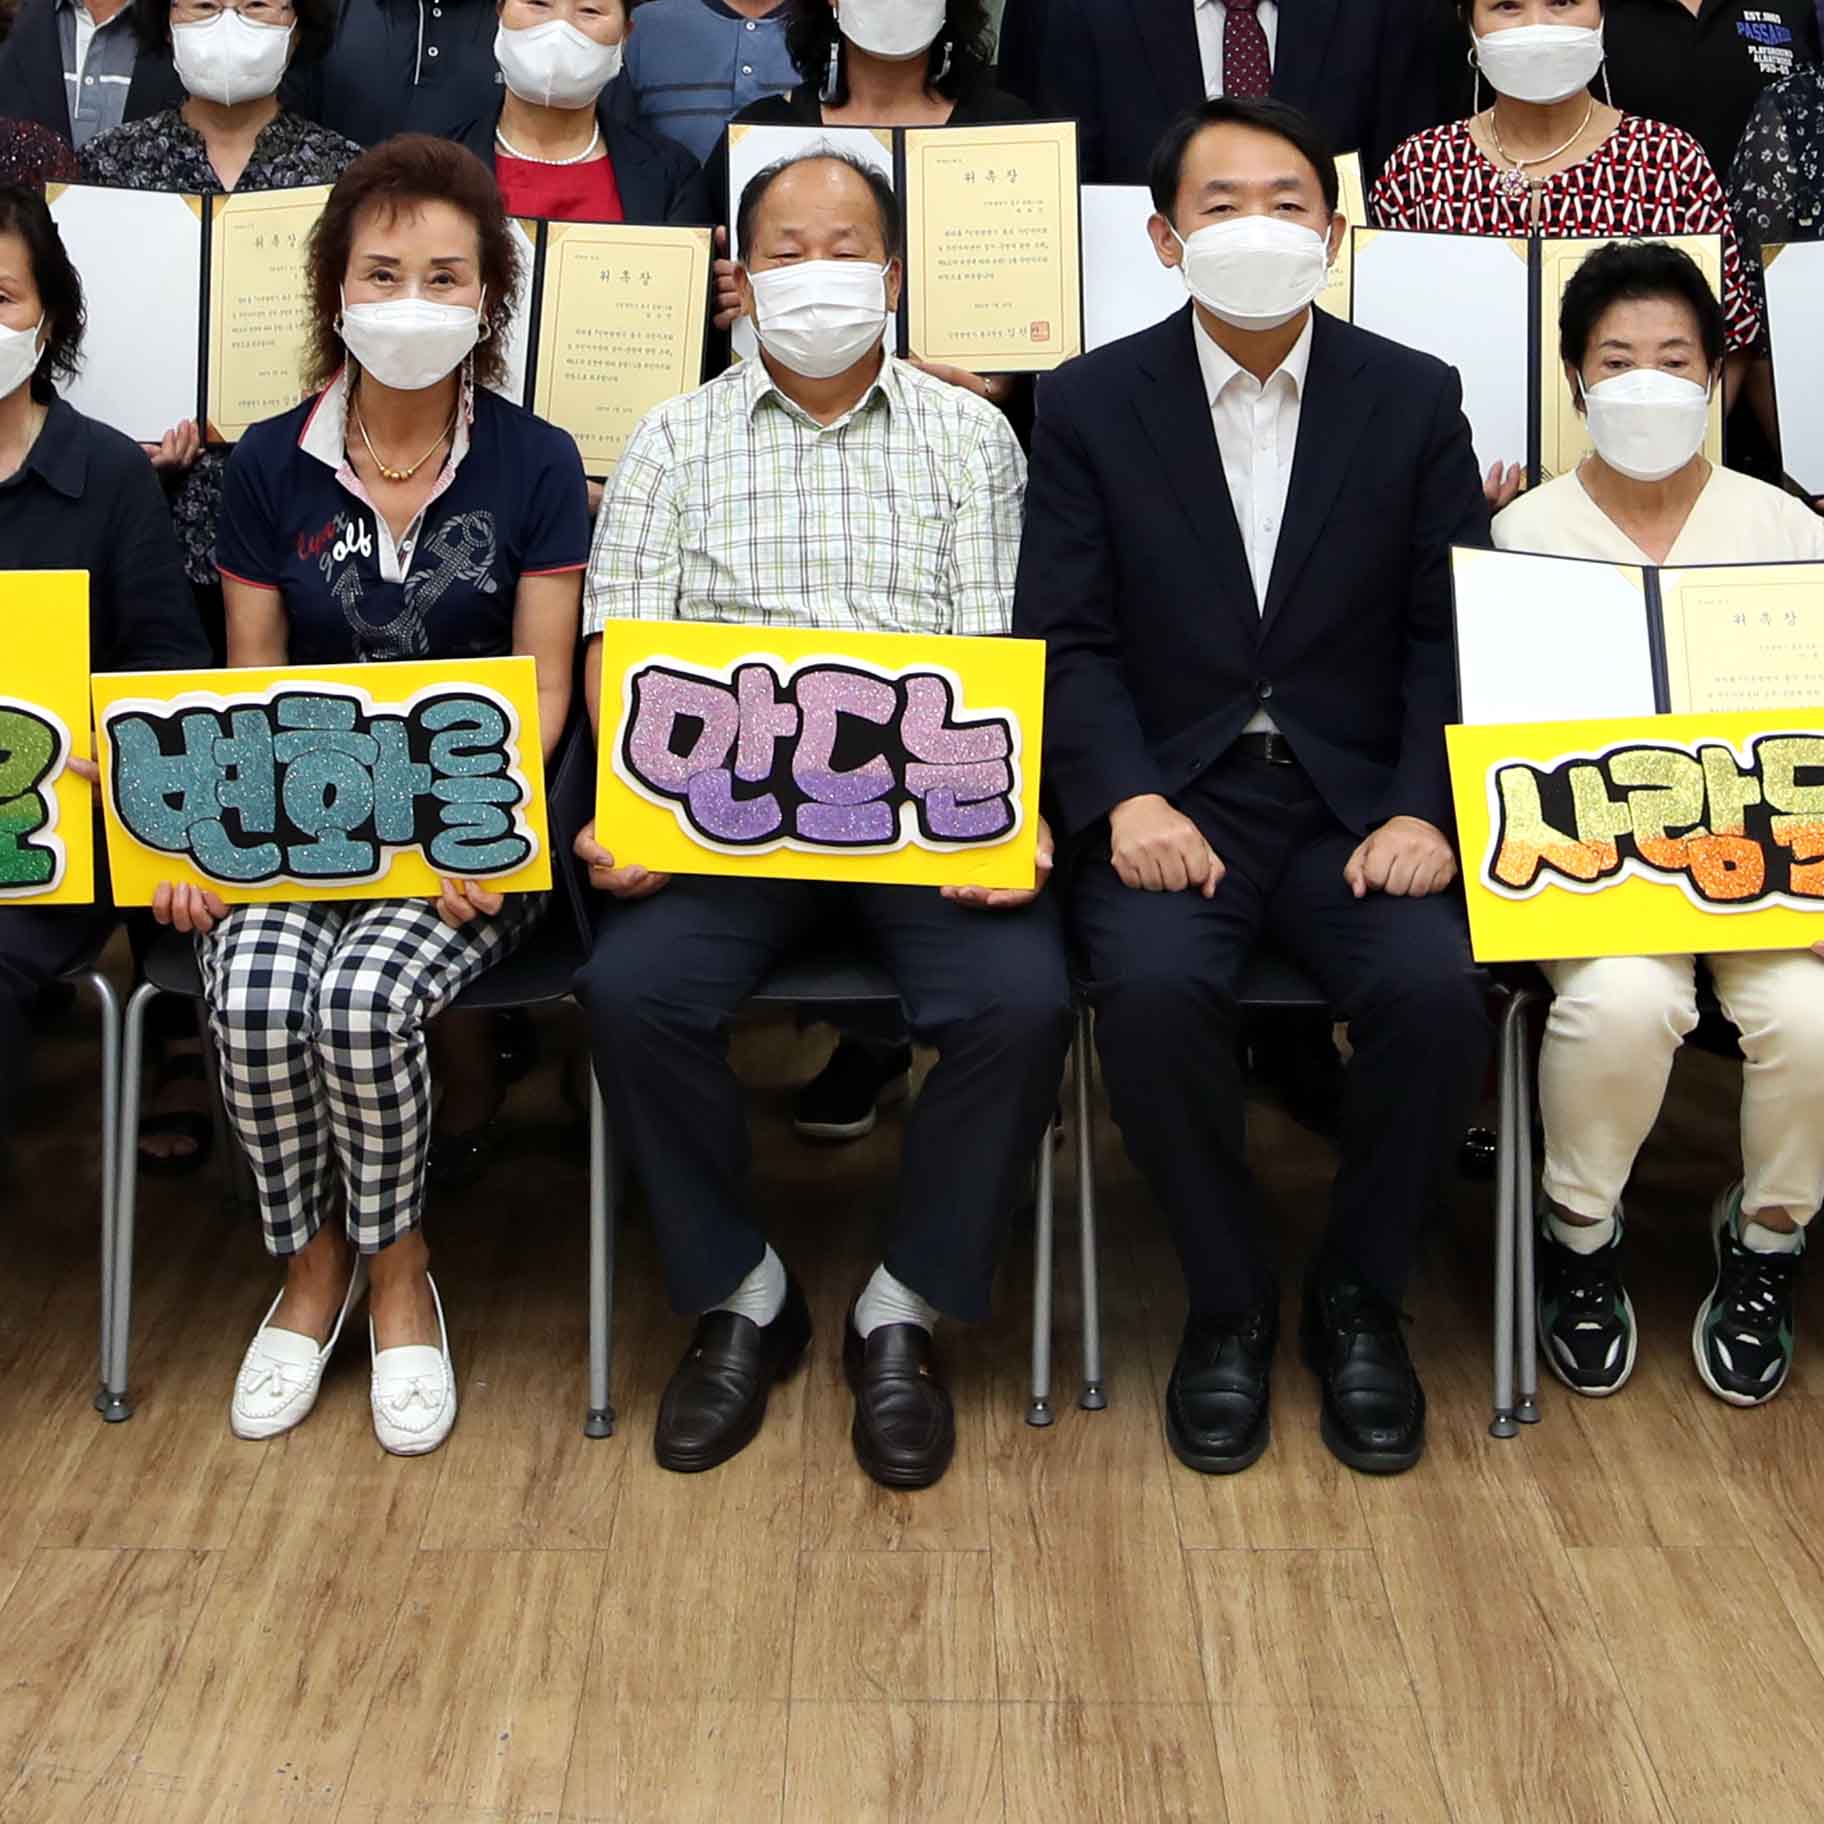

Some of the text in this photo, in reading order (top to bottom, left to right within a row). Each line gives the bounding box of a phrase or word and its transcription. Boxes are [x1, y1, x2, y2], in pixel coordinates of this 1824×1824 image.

[319, 517, 372, 583] golf
[104, 690, 531, 882] 변화를
[623, 663, 1016, 844] 만드는
